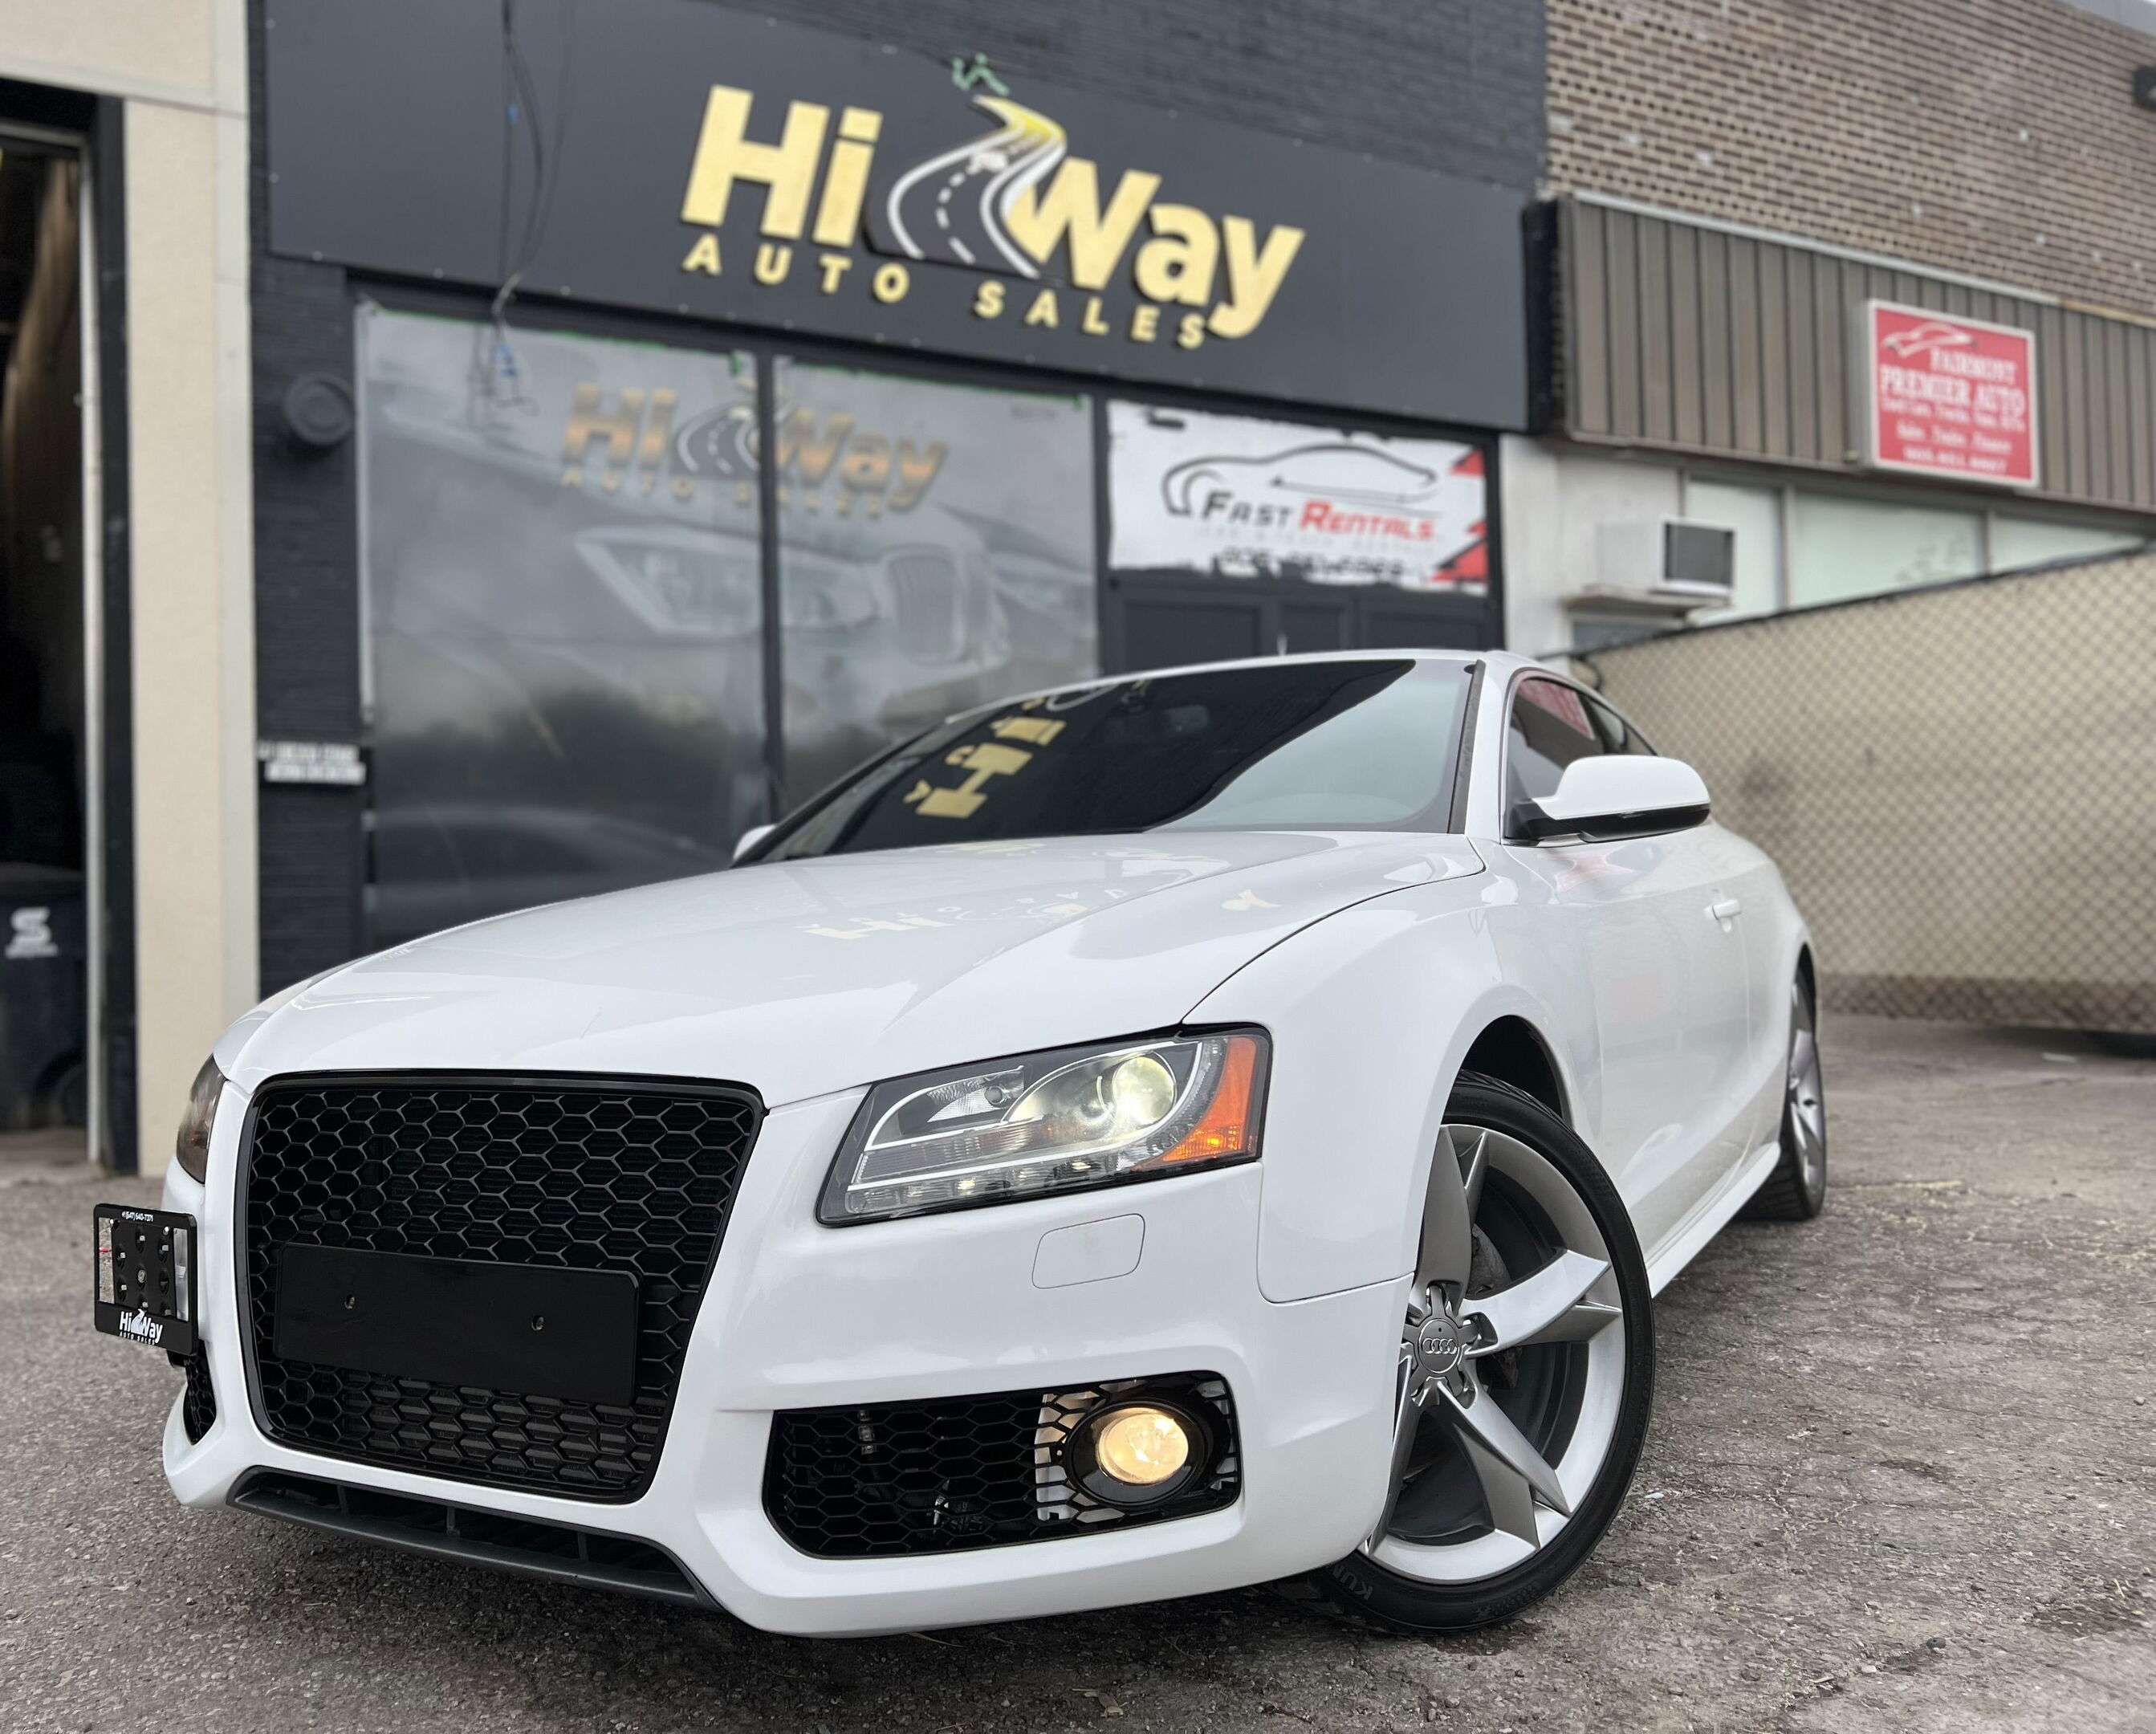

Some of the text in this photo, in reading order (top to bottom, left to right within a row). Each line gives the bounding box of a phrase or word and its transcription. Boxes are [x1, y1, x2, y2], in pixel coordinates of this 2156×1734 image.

[681, 84, 1305, 338] Hi Way
[681, 234, 1208, 349] AUTO SALES
[119, 1311, 132, 1332] Hi
